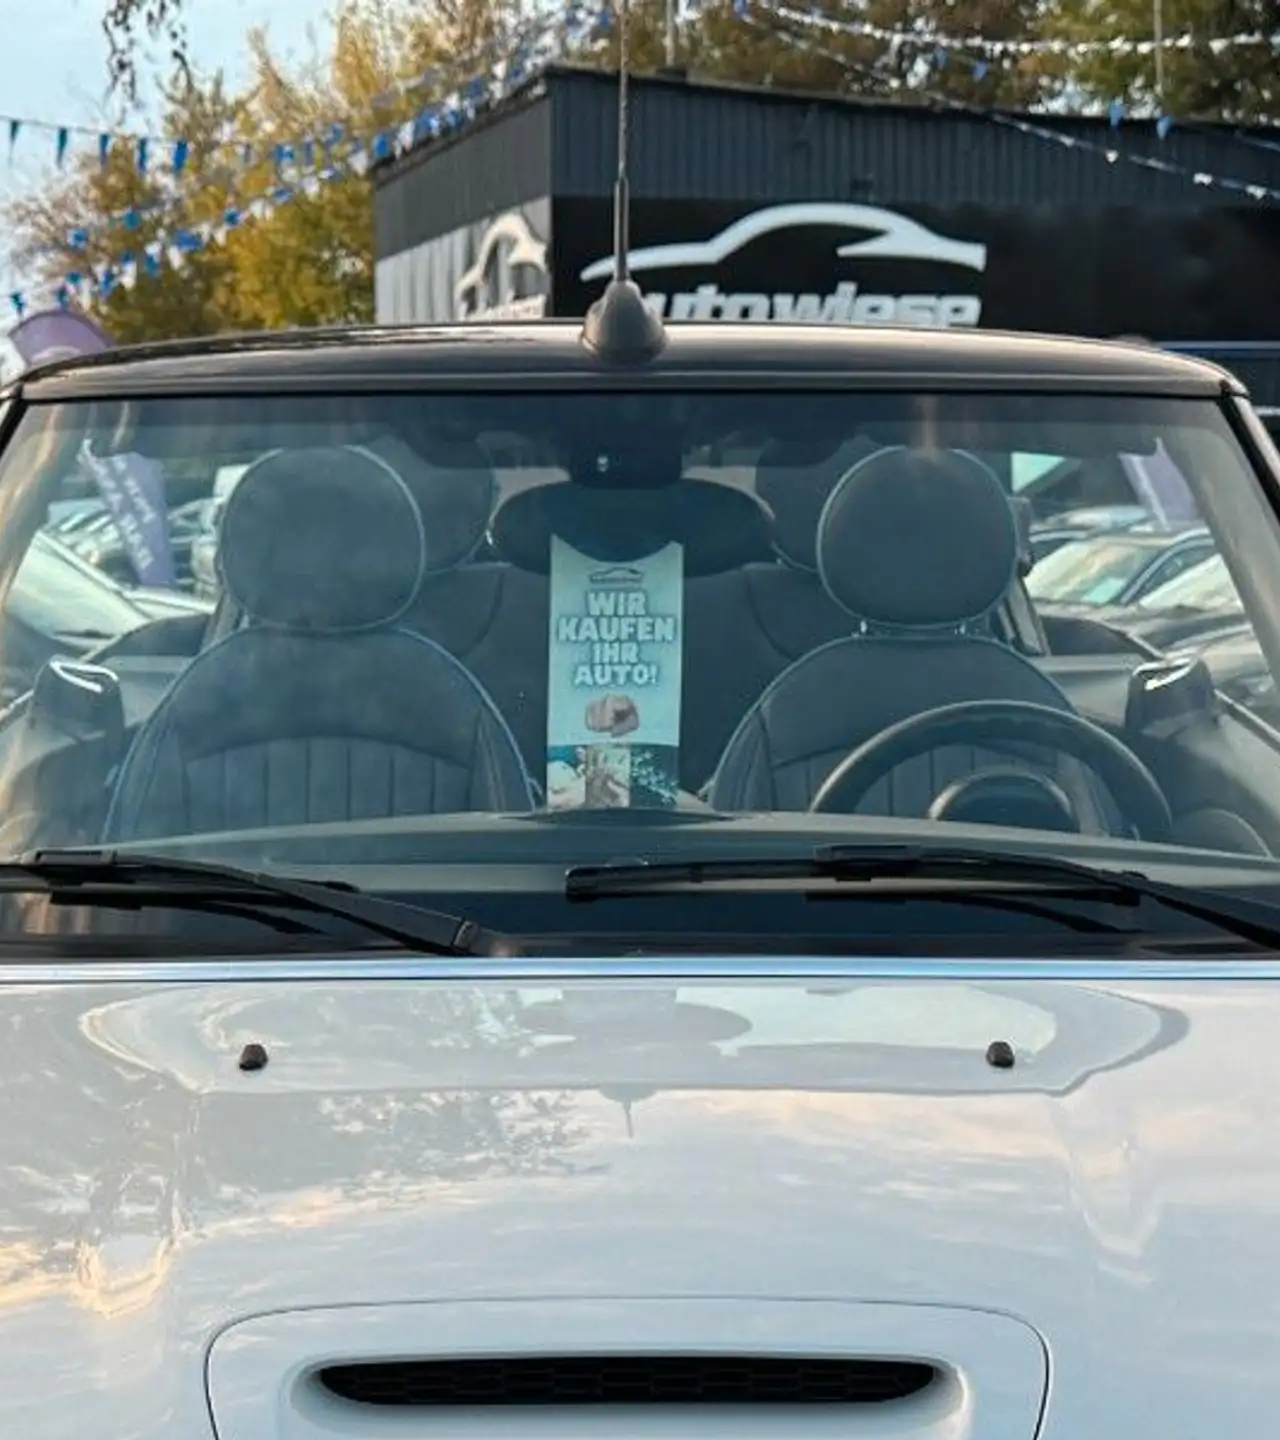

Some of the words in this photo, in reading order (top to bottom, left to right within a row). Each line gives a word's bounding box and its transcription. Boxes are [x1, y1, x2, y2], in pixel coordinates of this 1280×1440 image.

[645, 282, 983, 327] utowiese
[587, 592, 647, 616] WIR
[558, 616, 675, 641] KAUFEN
[592, 641, 639, 664] IHR
[574, 663, 659, 687] AUTO!
